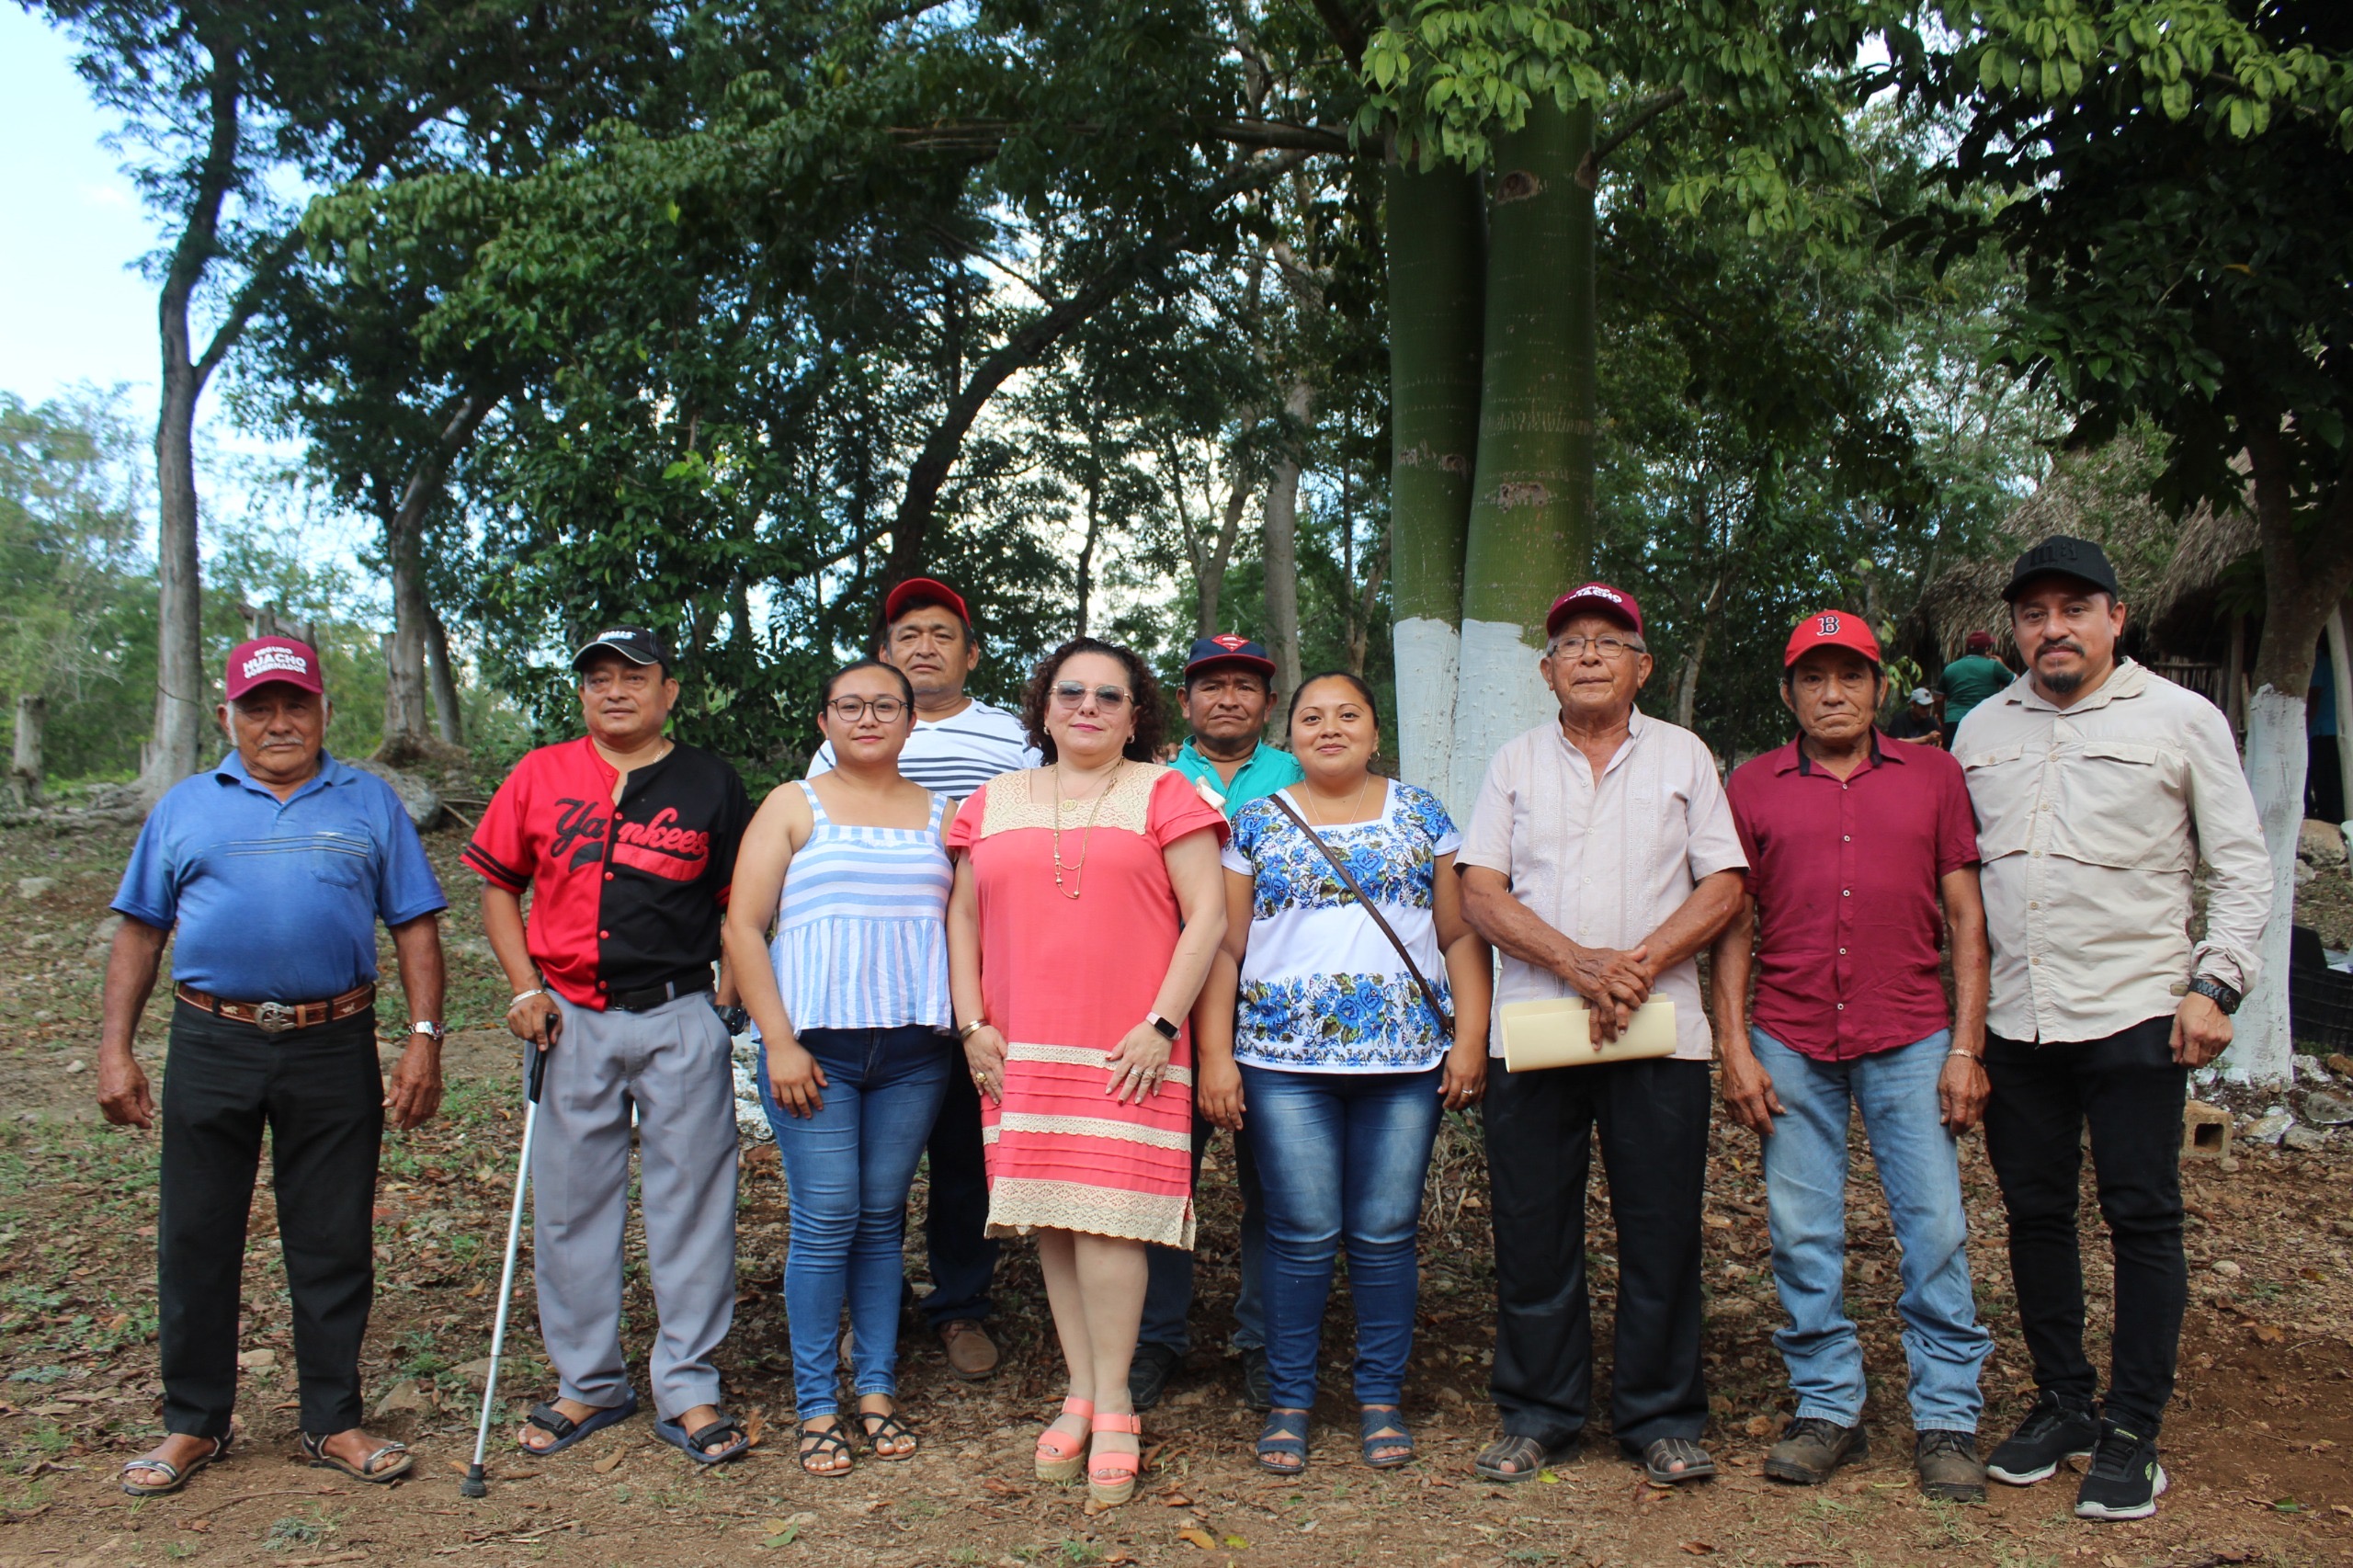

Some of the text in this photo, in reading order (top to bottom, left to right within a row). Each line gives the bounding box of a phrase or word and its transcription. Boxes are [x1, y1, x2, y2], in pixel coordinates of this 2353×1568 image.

[1816, 615, 1840, 636] B
[254, 646, 293, 657] SEGURO
[243, 653, 307, 675] HUACHO
[244, 663, 307, 679] GOBERNADOR
[551, 798, 710, 858] Yankees
